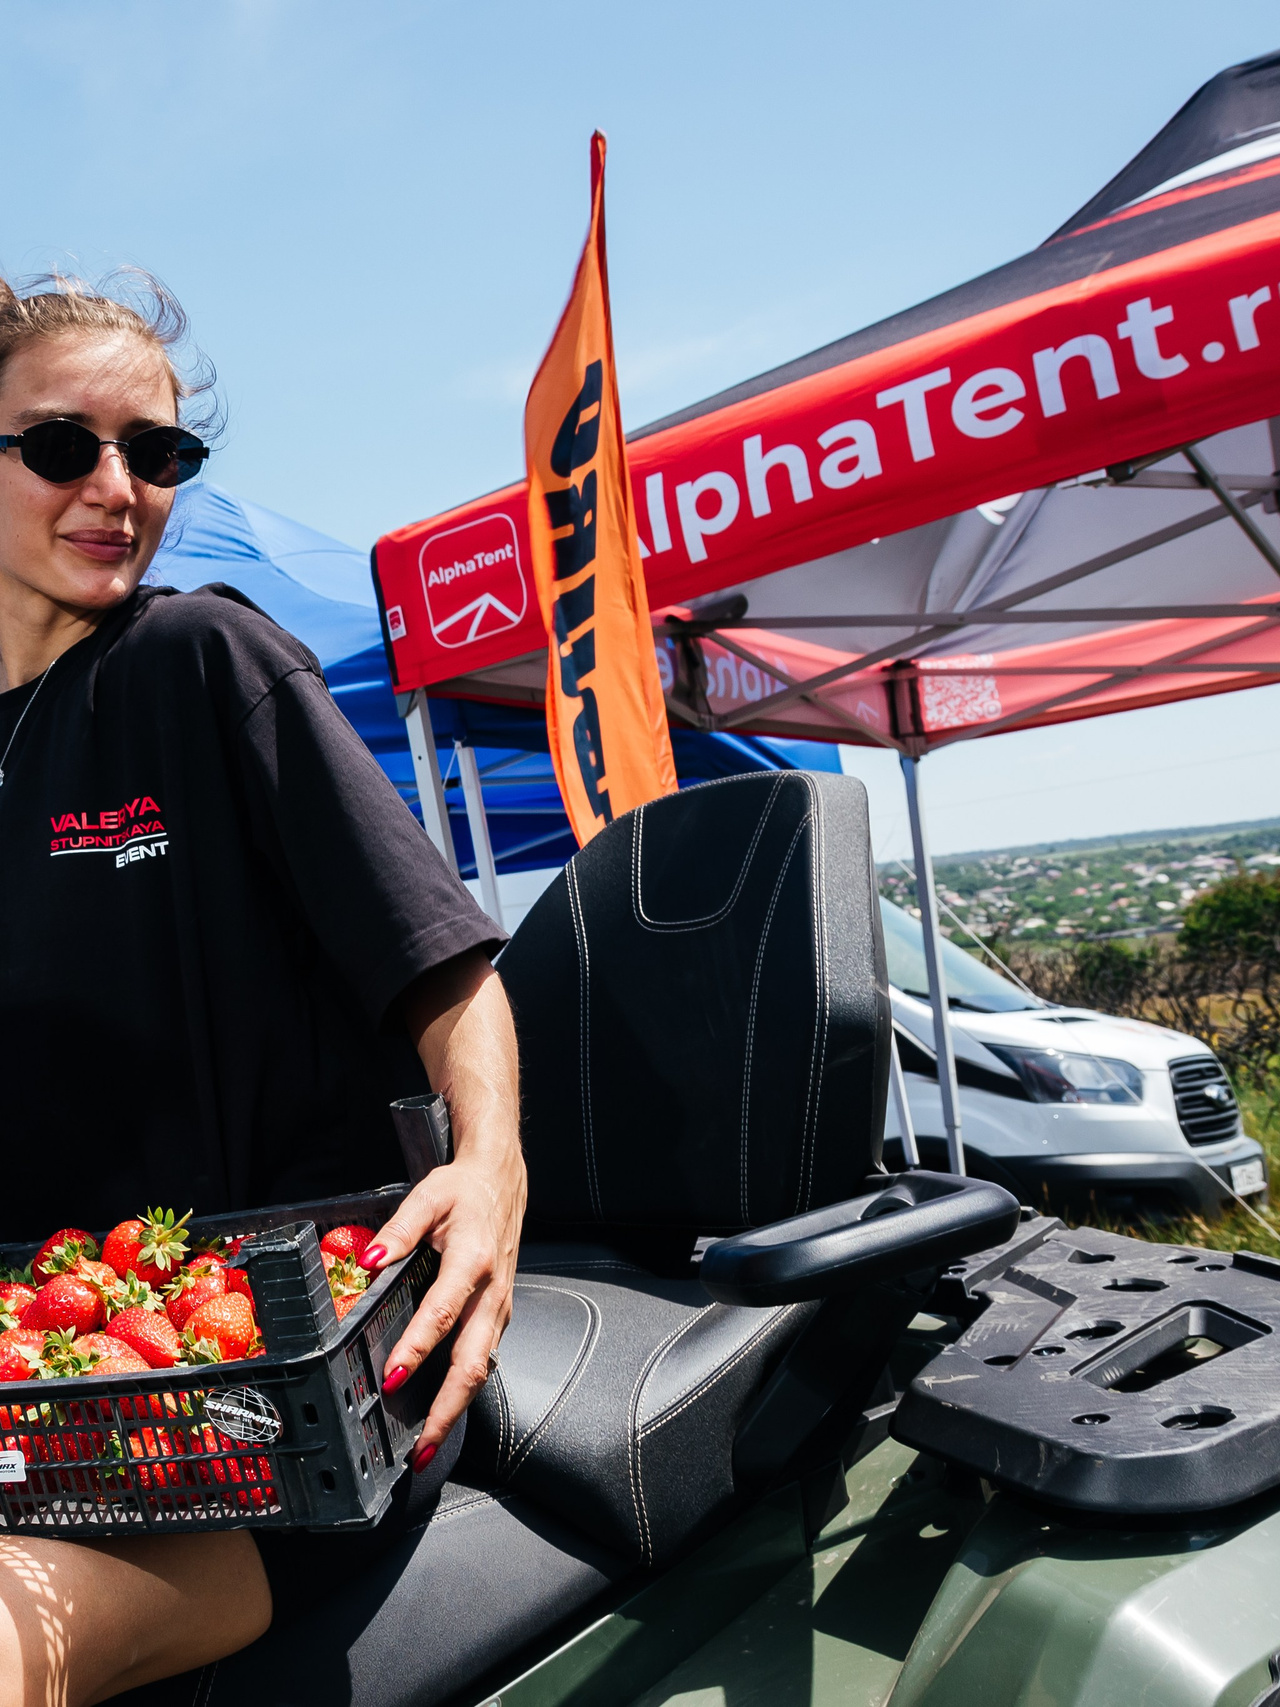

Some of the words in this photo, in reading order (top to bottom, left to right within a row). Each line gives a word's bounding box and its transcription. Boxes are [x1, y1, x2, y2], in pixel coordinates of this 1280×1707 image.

[635, 280, 1280, 564] lphaTent.r
[428, 543, 514, 588] AlphaTent
[50, 796, 162, 833] VALERYA
[116, 841, 169, 868] EVENT
[203, 1400, 281, 1429] SHARMAX
